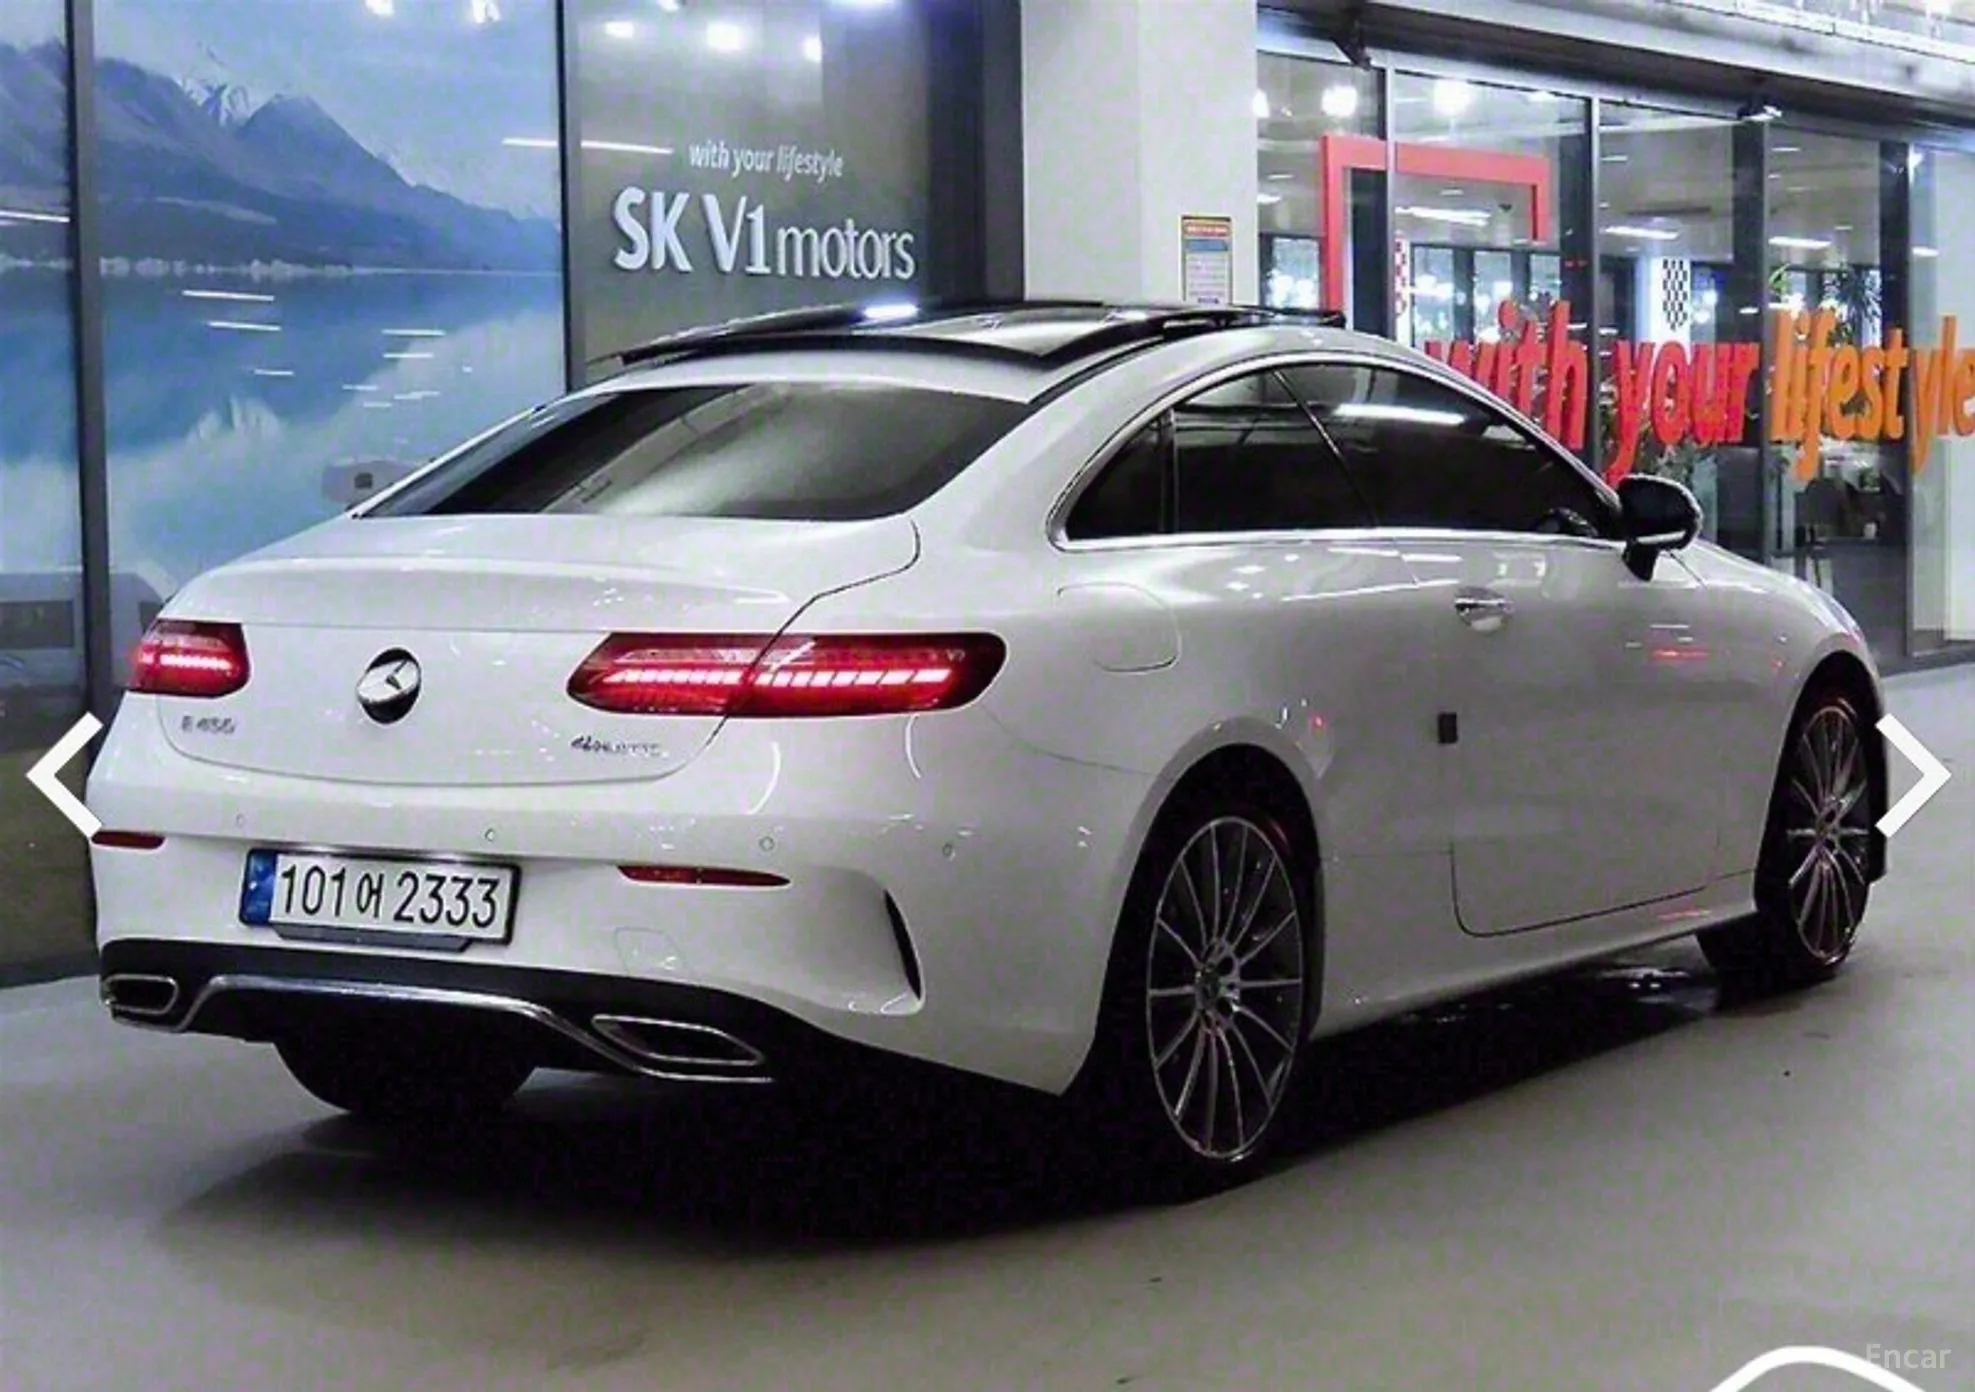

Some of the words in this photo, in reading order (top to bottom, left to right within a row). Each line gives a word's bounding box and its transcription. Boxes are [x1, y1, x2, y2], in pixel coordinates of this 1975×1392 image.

[688, 140, 730, 169] with
[732, 147, 774, 179] your
[776, 144, 844, 183] lifestyle
[613, 186, 693, 272] SK
[1606, 340, 1760, 487] your
[393, 870, 499, 928] 2333
